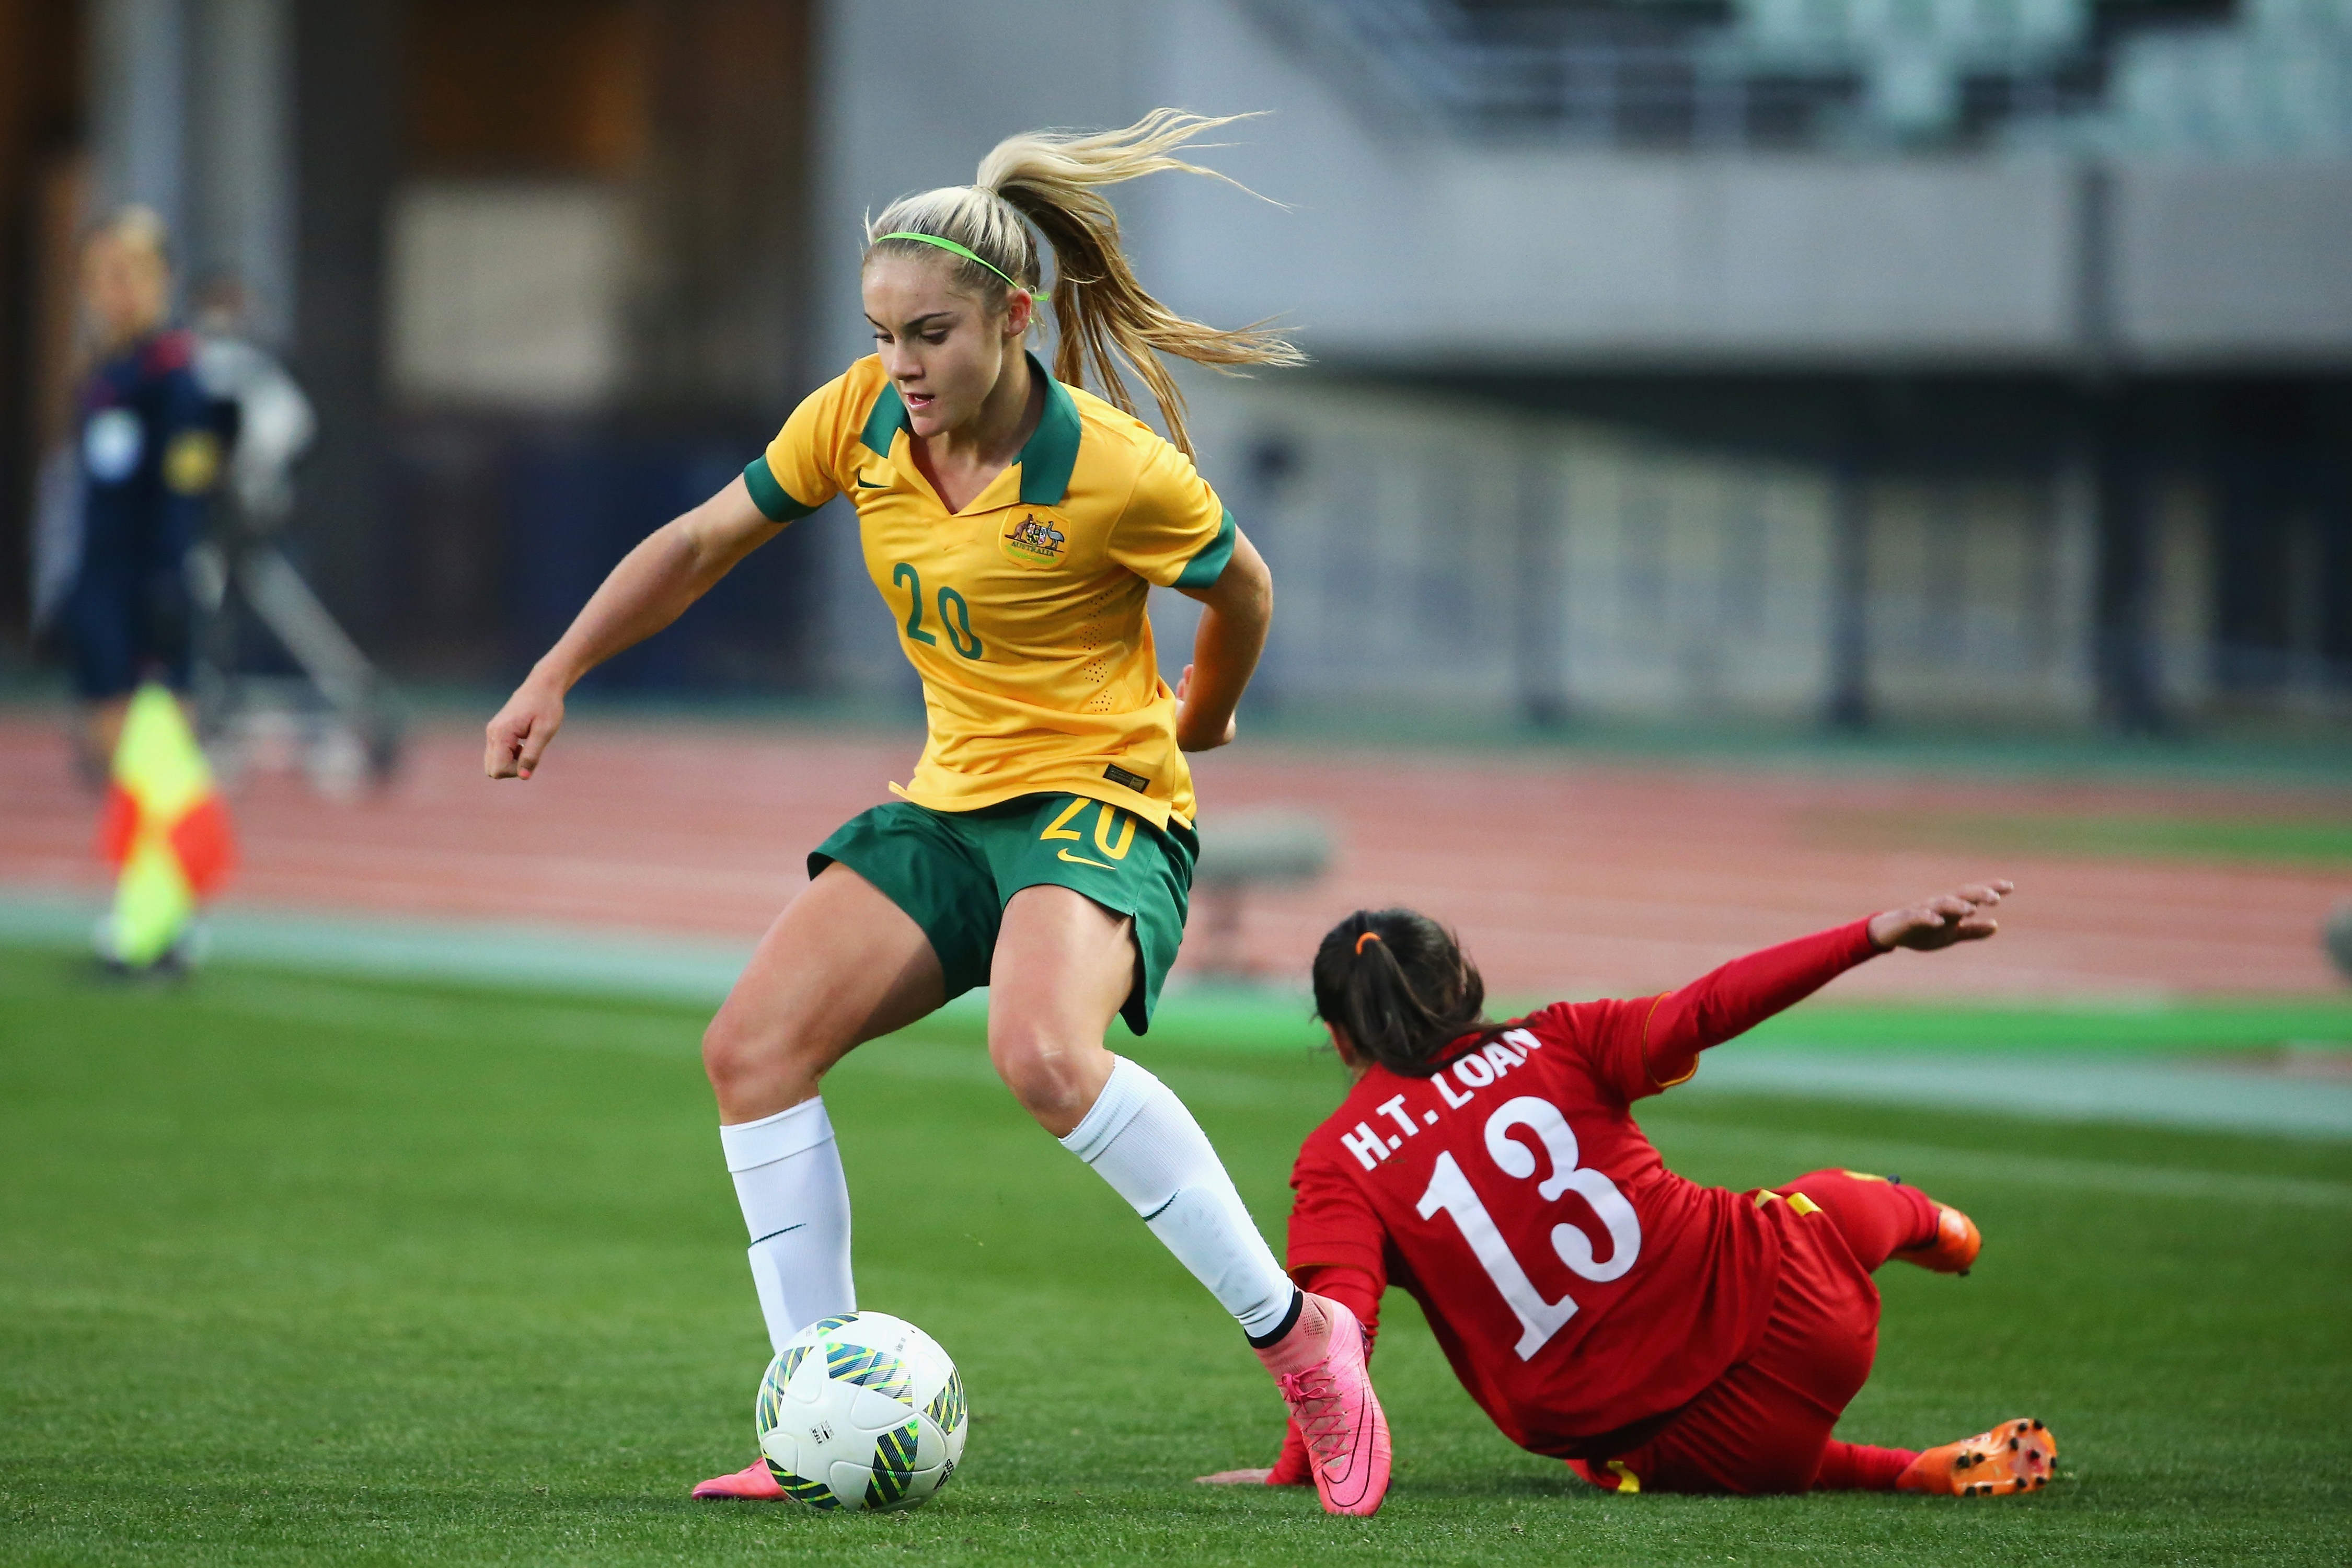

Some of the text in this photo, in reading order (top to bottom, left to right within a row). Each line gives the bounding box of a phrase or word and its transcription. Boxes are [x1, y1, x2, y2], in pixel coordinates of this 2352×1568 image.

[1011, 541, 1054, 557] AUSTRALIA
[893, 562, 983, 661] 20
[1341, 1028, 1542, 1171] H.T. LOAN
[1416, 1096, 1642, 1362] 13
